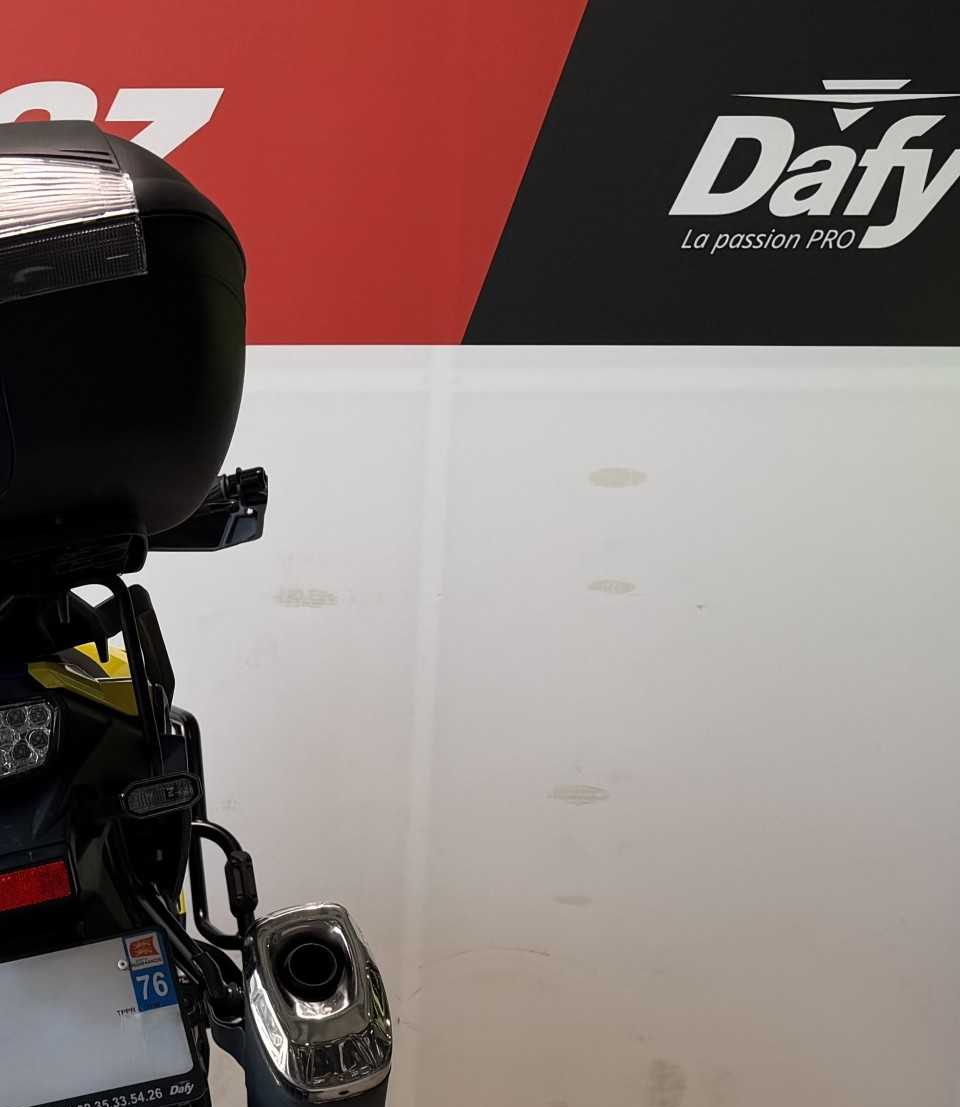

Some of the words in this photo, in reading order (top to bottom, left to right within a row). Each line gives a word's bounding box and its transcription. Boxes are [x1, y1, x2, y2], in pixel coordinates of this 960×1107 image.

[668, 115, 960, 249] Dafy
[681, 229, 710, 249] La
[710, 229, 801, 254] passion
[806, 229, 856, 249] PRO
[136, 971, 169, 1000] 76
[169, 1081, 194, 1096] Dafy
